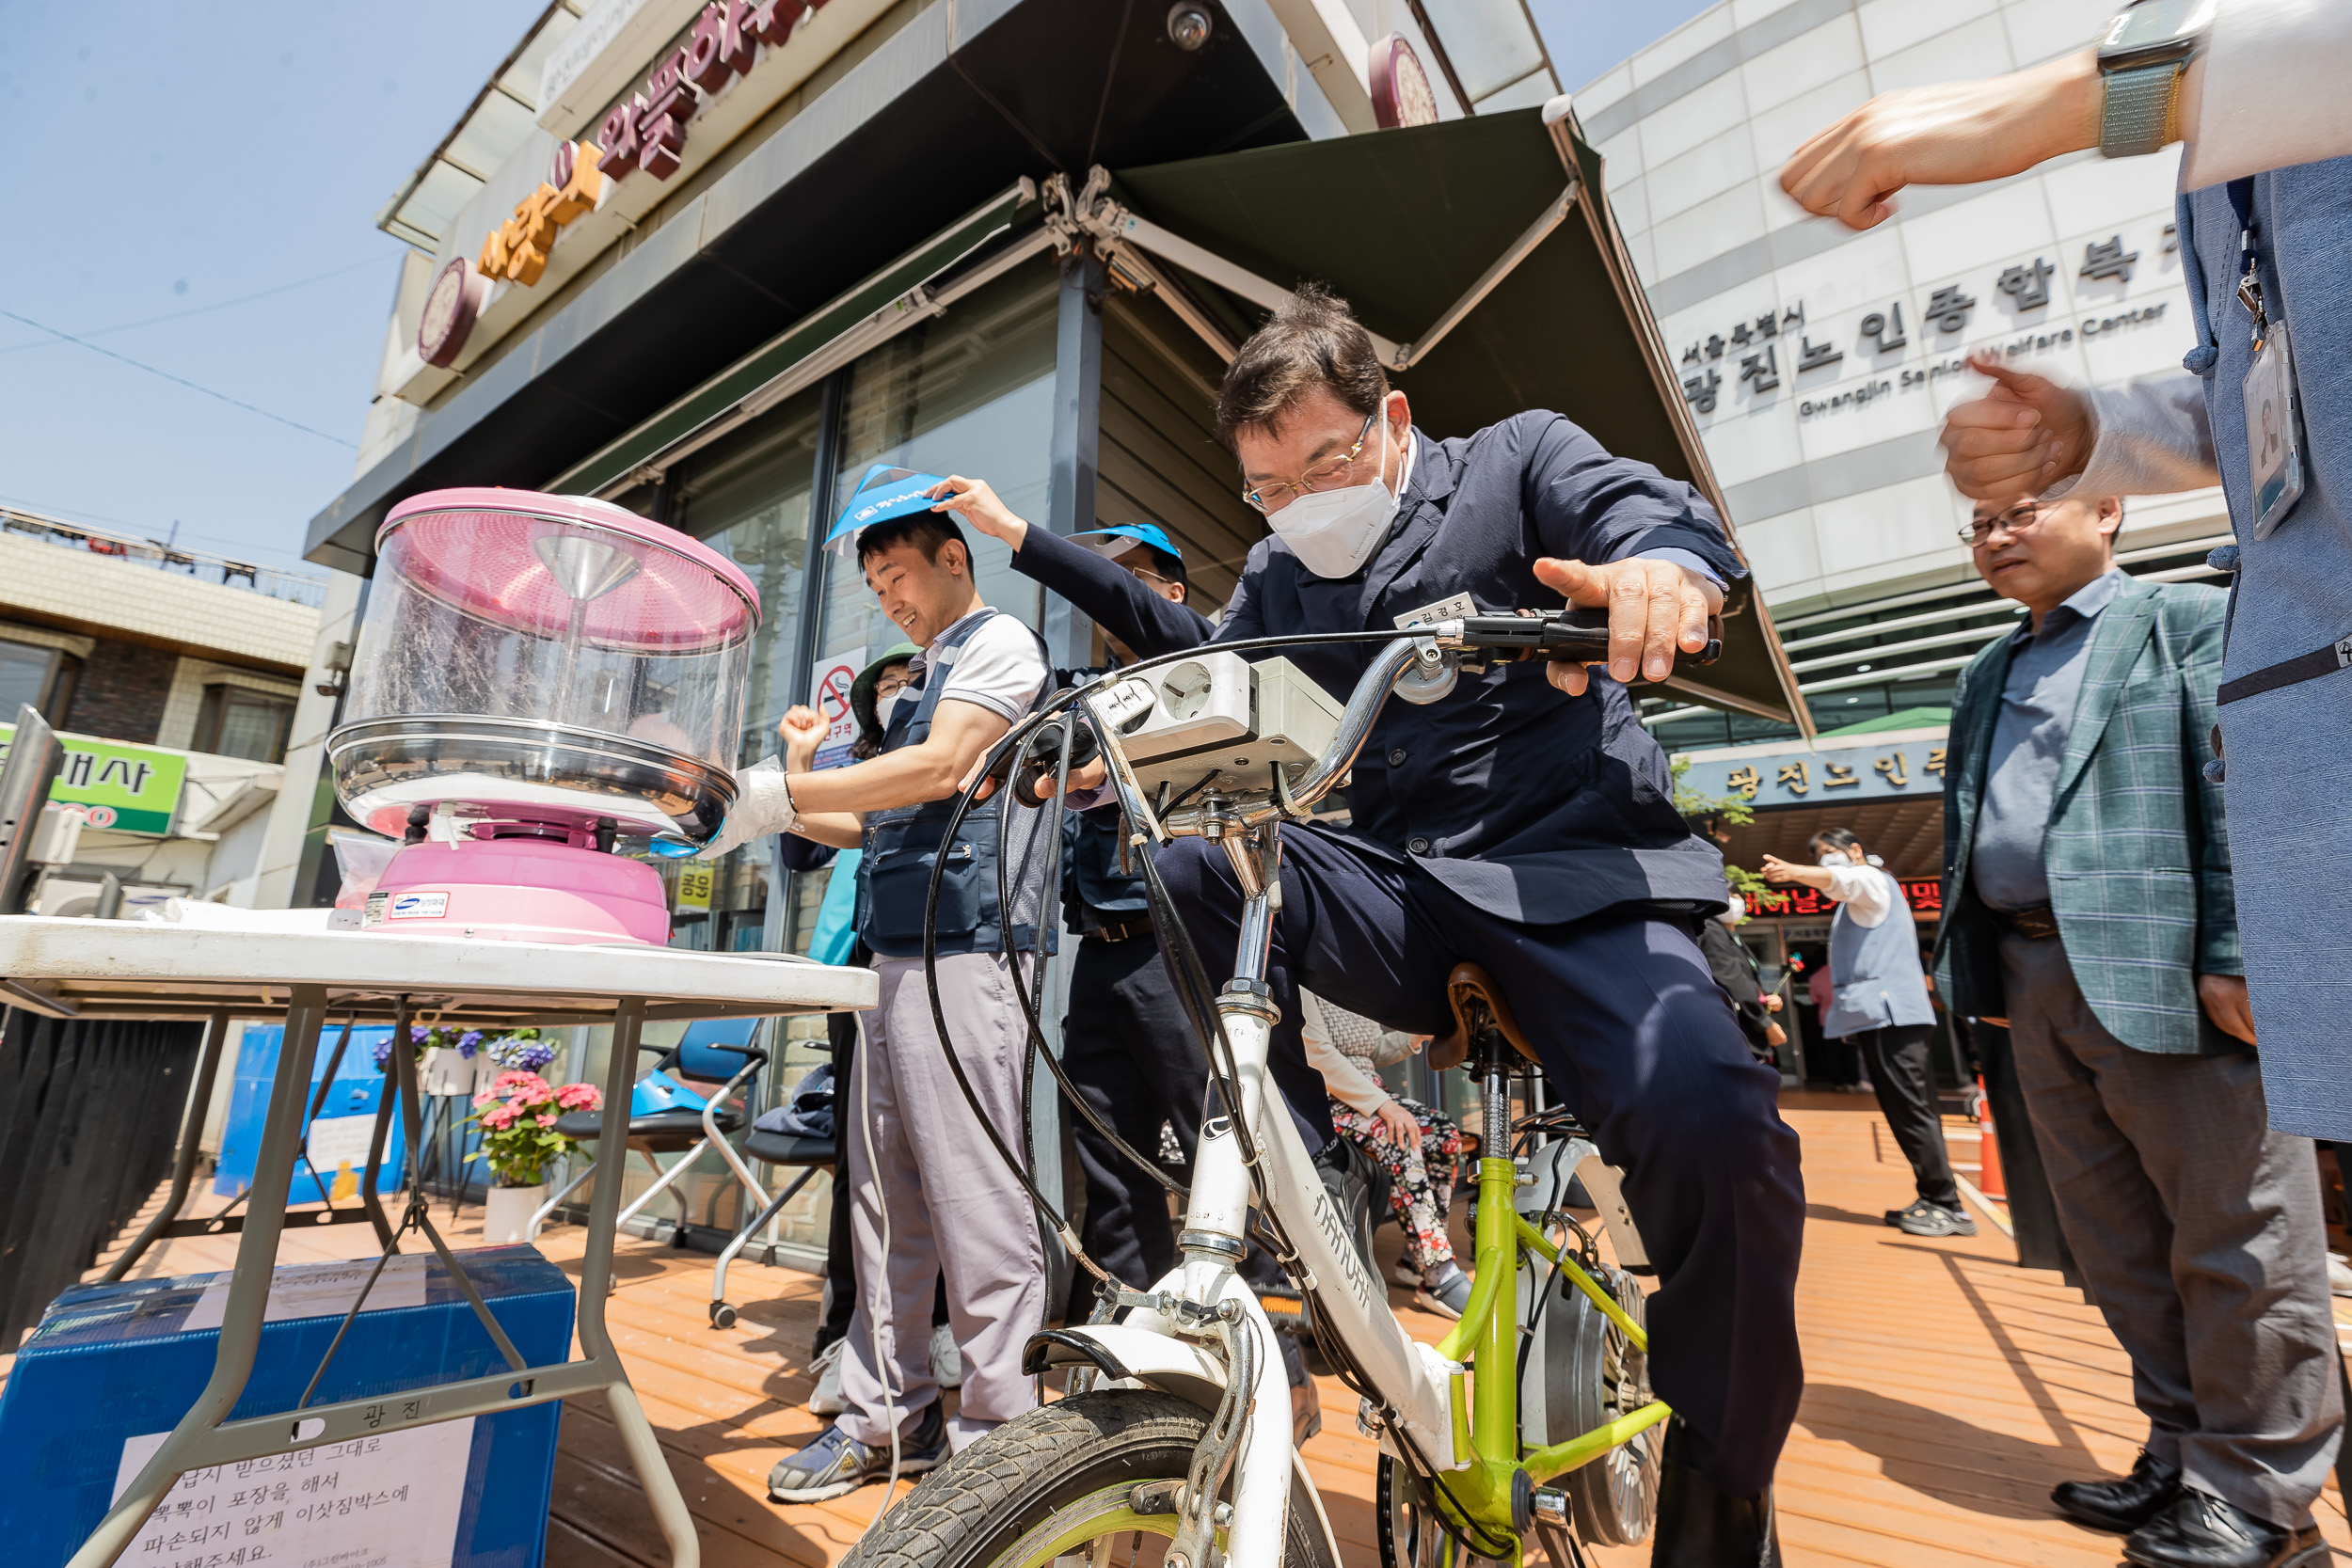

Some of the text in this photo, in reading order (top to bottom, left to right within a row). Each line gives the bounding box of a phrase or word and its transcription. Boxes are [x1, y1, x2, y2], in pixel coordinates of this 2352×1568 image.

[1681, 298, 1805, 364] 서울특별시
[1800, 376, 1892, 417] Gwangjin
[2081, 301, 2168, 335] Center
[171, 1465, 222, 1492] 납시
[325, 1437, 382, 1461] 그대로
[226, 1481, 291, 1510] 포장을
[301, 1470, 340, 1494] 해서
[143, 1484, 409, 1554] 파손되지 않게 이삿짐박스에
